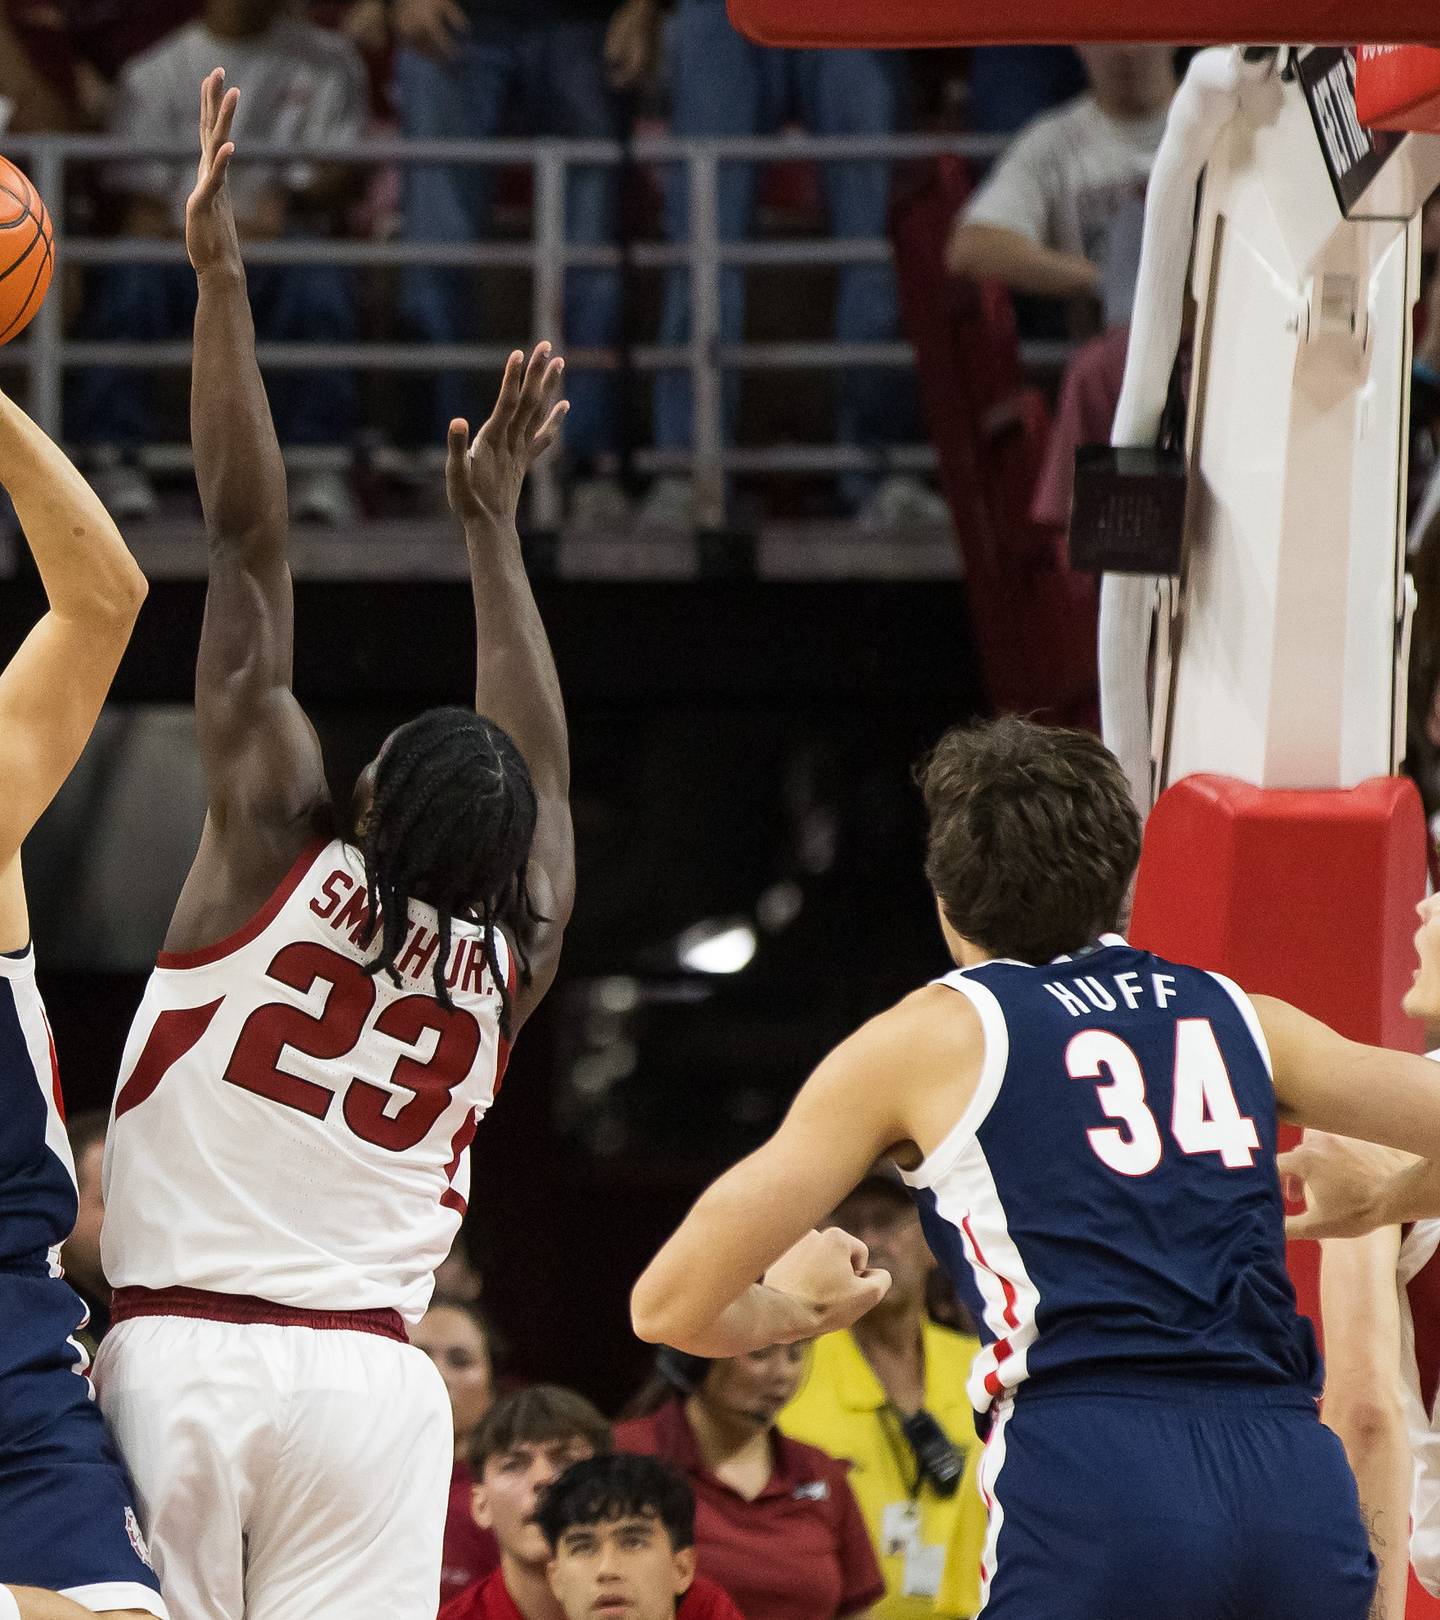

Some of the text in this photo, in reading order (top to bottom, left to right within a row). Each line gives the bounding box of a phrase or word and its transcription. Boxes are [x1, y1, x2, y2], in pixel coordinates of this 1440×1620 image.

[310, 870, 439, 979] SMH
[222, 941, 481, 1152] 23
[1043, 972, 1177, 1017] HUFF
[1063, 1017, 1262, 1178] 34
